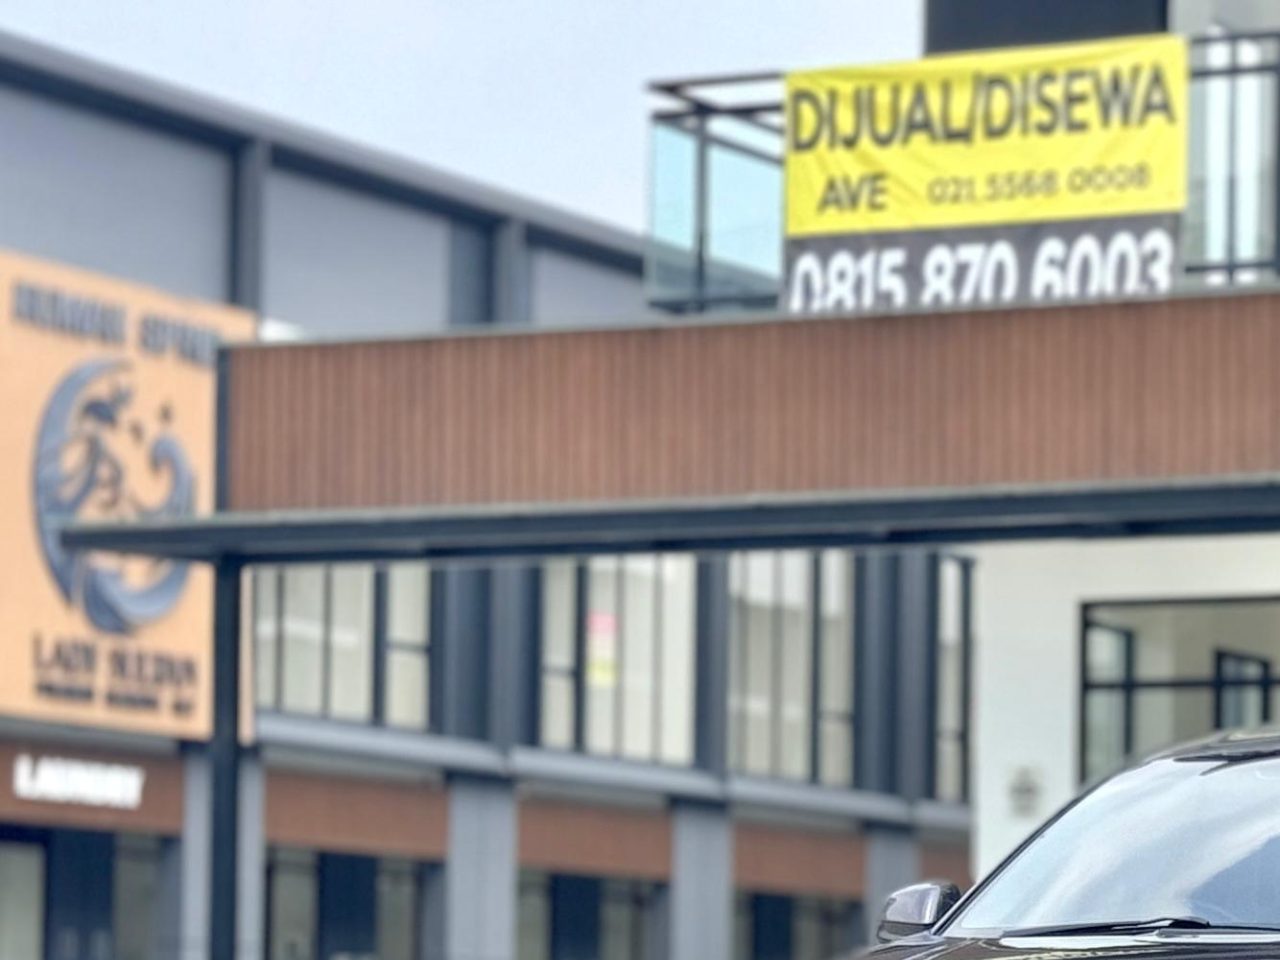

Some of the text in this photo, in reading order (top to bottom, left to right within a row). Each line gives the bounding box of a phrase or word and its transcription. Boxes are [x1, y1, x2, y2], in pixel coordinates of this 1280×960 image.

[790, 62, 1176, 153] DIJUAL/DISEWA
[816, 171, 889, 214] AVE
[789, 227, 1174, 313] 0815 870 6003
